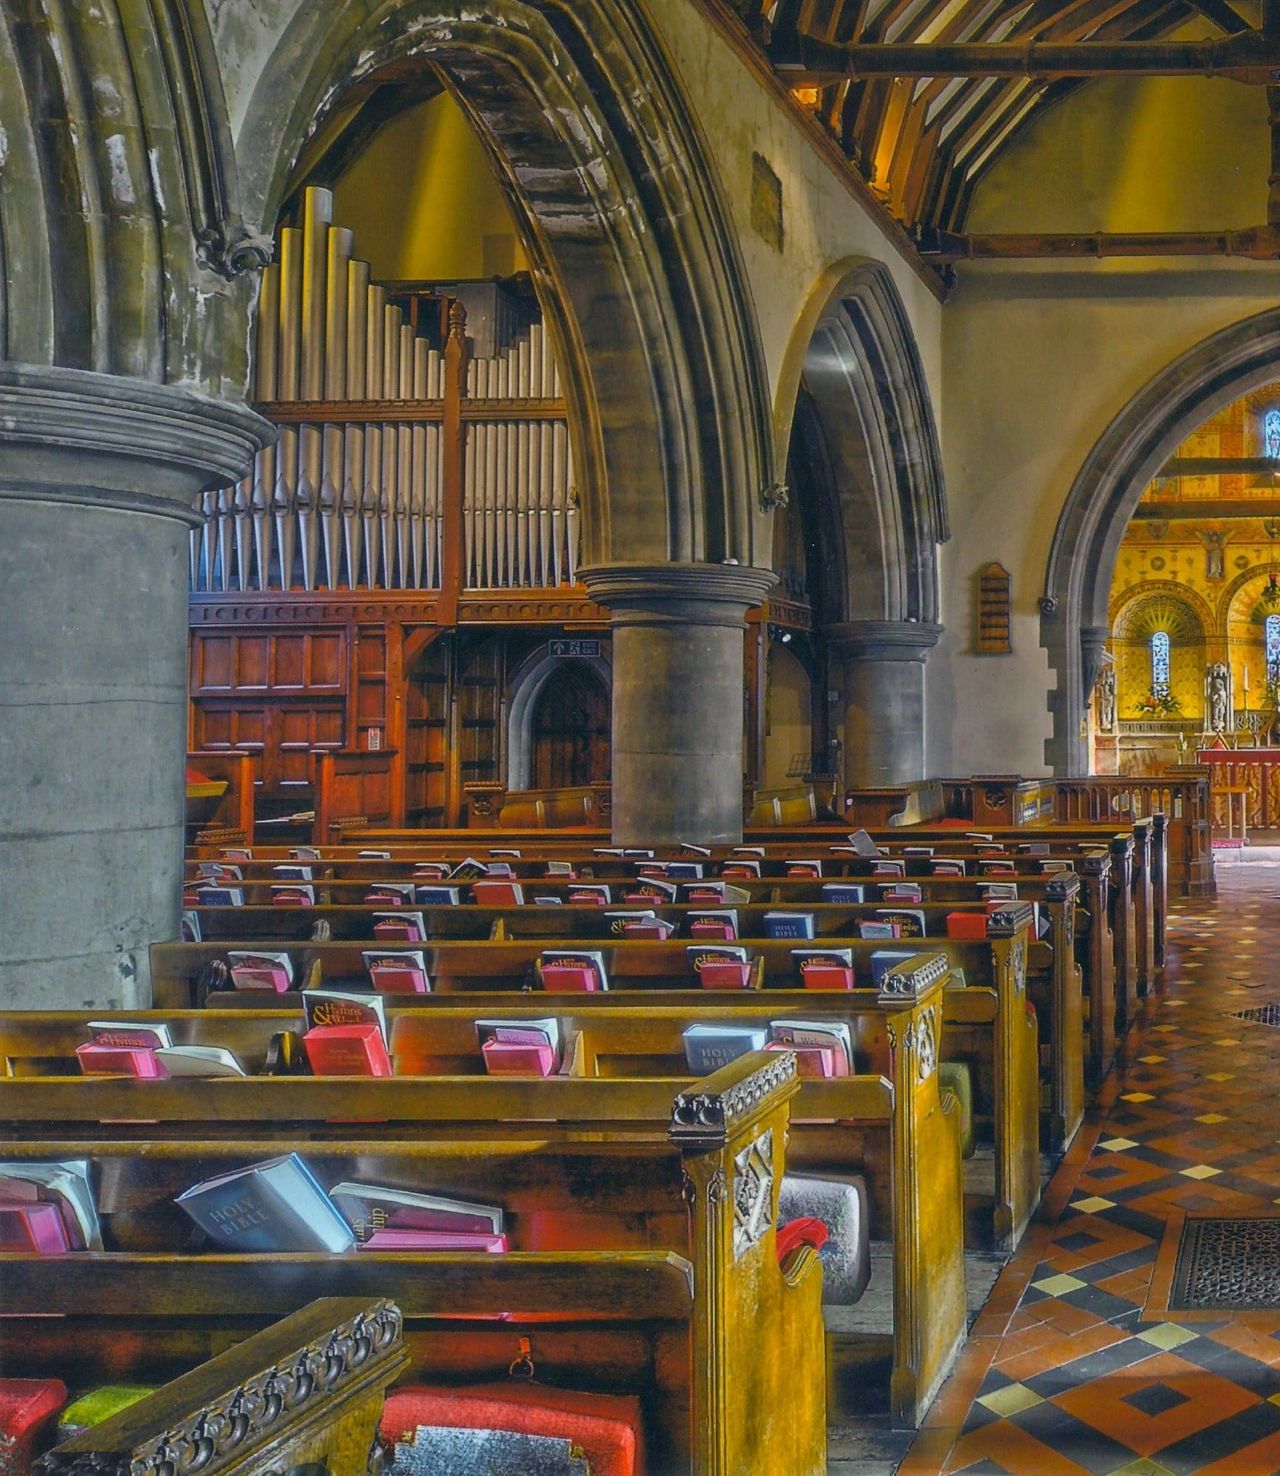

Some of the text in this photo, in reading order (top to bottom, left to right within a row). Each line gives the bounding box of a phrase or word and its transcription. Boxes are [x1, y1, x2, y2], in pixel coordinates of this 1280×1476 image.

[324, 1002, 362, 1017] Hymns
[702, 1048, 737, 1057] HOLY
[209, 1198, 256, 1224] HOLY
[219, 1210, 271, 1236] BIBLE
